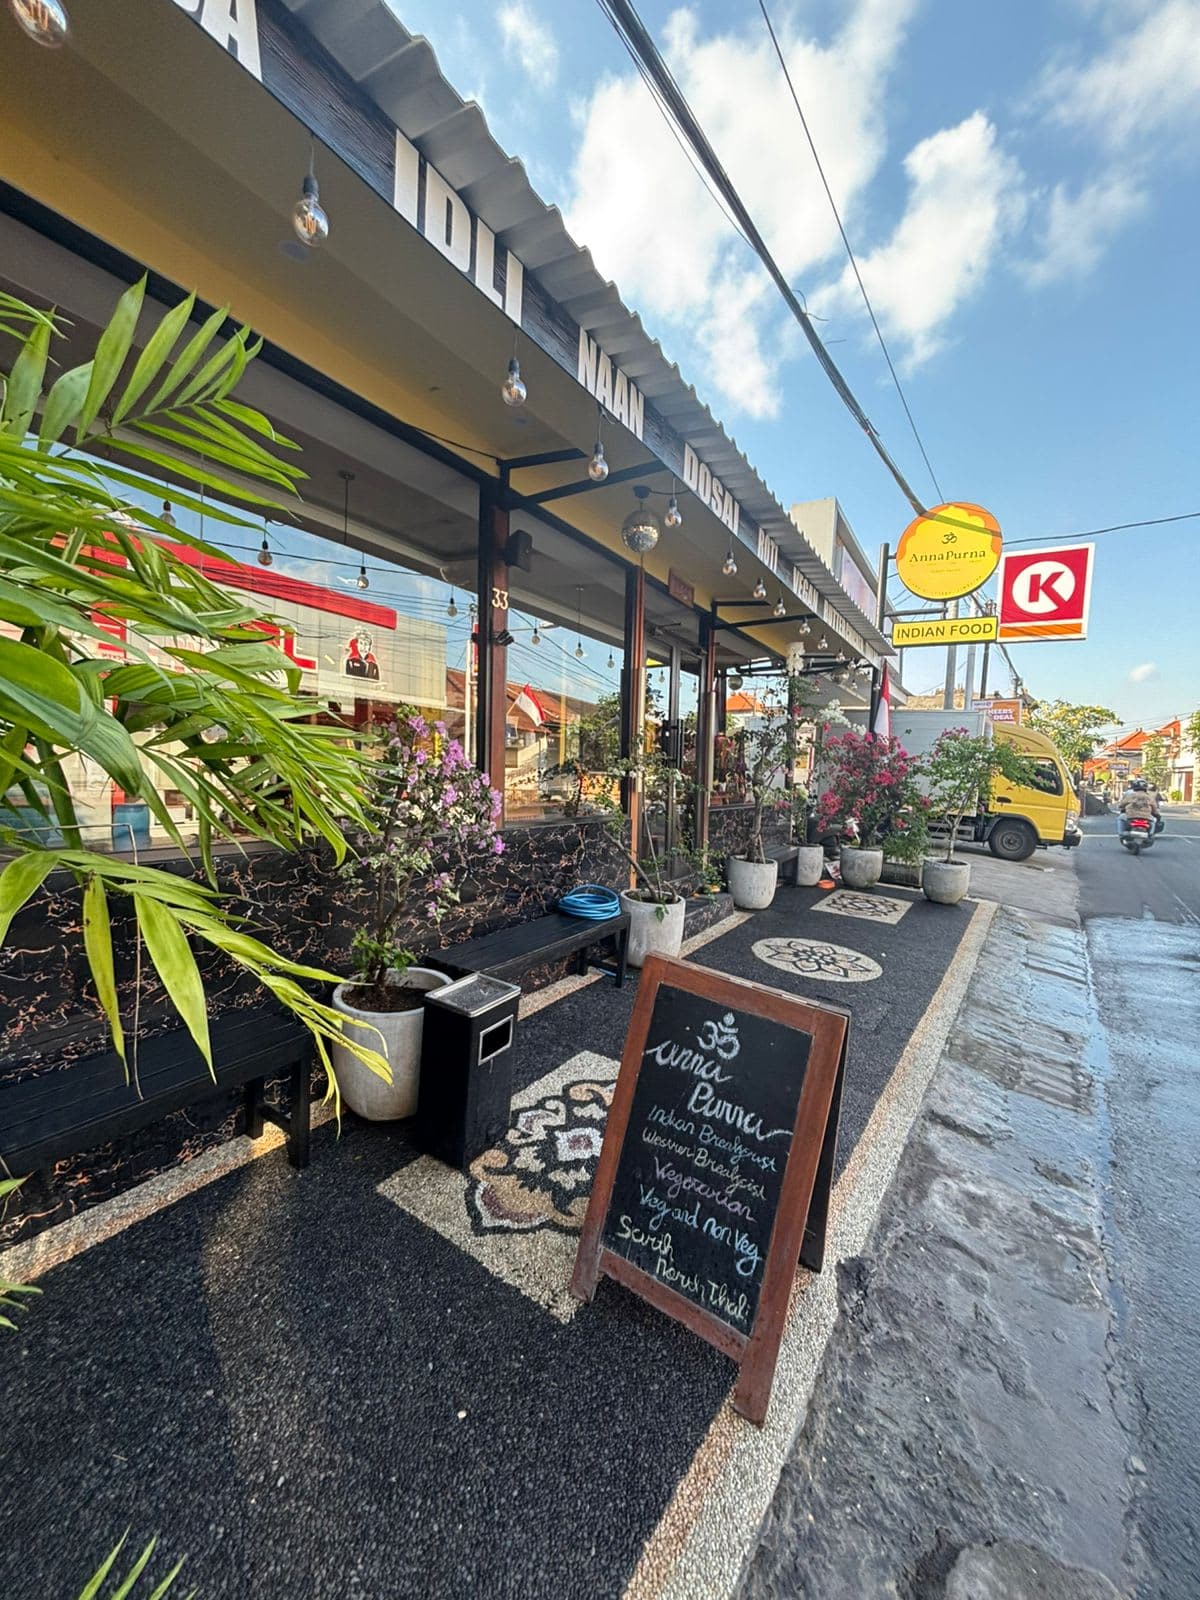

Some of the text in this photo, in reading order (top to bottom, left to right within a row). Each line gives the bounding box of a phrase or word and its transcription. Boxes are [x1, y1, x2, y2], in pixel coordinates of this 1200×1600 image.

[173, 0, 263, 83] A
[394, 128, 524, 327] IDLI
[577, 325, 645, 442] NAAN
[683, 442, 740, 537] DOSAI
[757, 527, 779, 575] ROTI
[492, 587, 509, 610] 33
[1028, 571, 1066, 608] K
[896, 622, 993, 640] INDIAN FOOD
[648, 1104, 696, 1135] Indian
[639, 1183, 671, 1232] Veg
[671, 1200, 700, 1230] and
